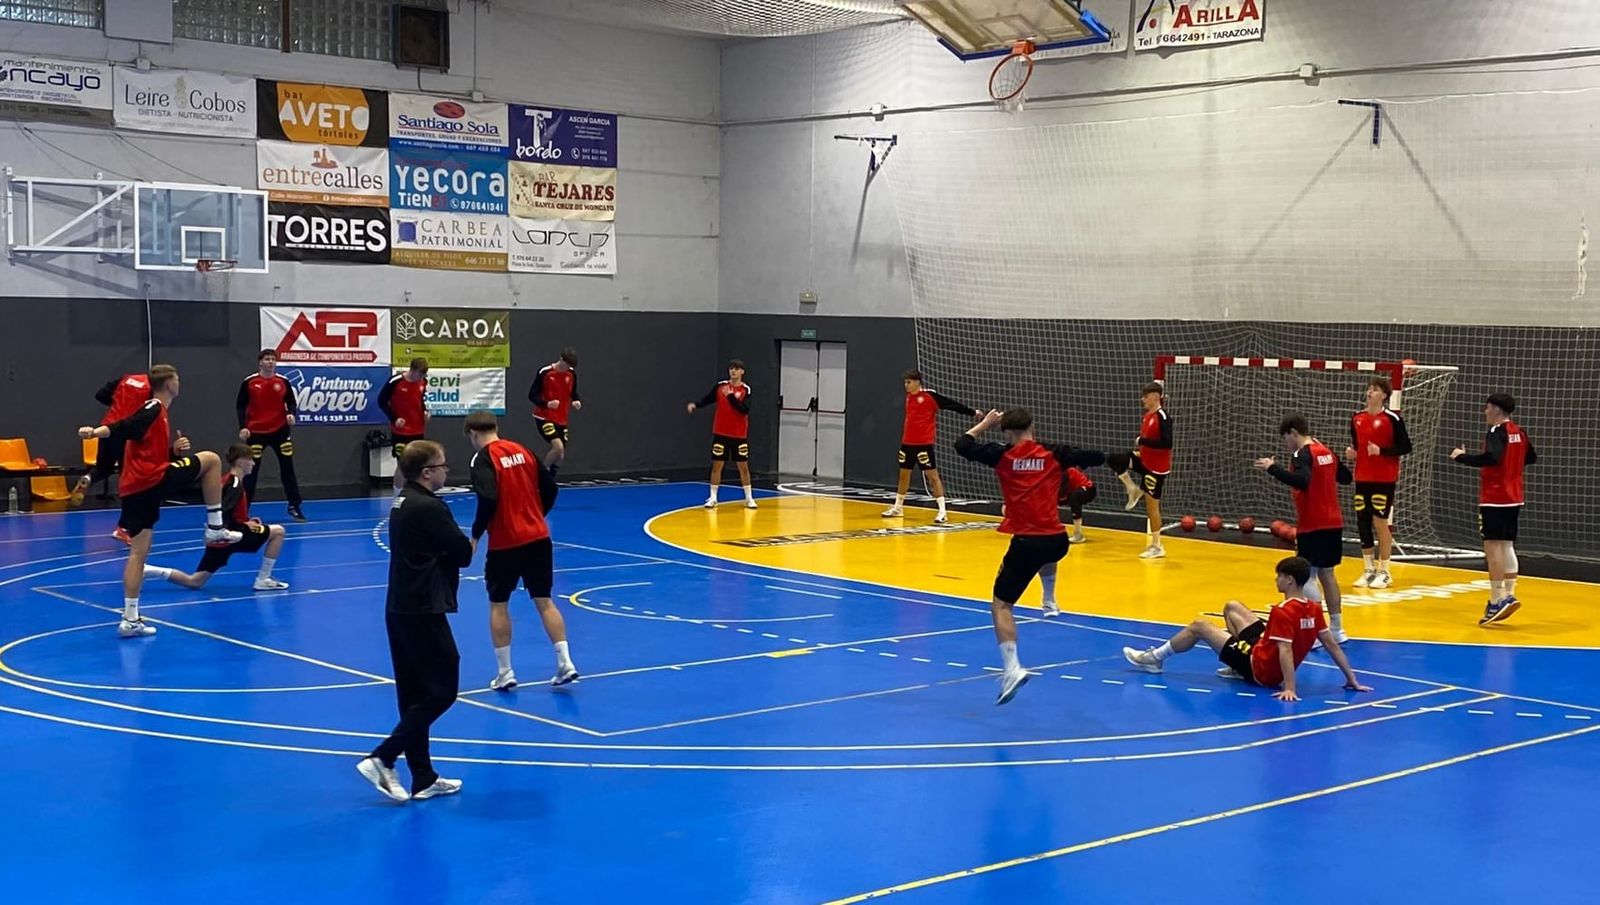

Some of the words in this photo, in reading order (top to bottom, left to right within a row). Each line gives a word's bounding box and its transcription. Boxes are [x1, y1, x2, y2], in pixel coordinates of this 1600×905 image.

[1173, 0, 1260, 28] ARILLA
[1213, 27, 1260, 39] TARAZONA
[3, 59, 101, 75] mantenimientos
[125, 83, 170, 107] Leire
[189, 89, 247, 113] Cobos
[138, 108, 172, 118] DIETISTA
[178, 110, 235, 122] NUTRICIONISTA
[279, 99, 370, 131] AVETO
[397, 114, 465, 134] Santiago
[467, 120, 500, 135] Sola
[516, 138, 562, 159] bordo
[262, 164, 384, 190] entrecalles
[394, 164, 506, 198] Yecora
[538, 170, 556, 182] BAR
[532, 180, 615, 202] TEJARES
[535, 201, 555, 209] SANTA
[555, 202, 574, 210] CRUZ
[574, 203, 584, 211] DE
[583, 204, 615, 213] MONCAYO
[267, 213, 388, 252] TORRES
[420, 218, 503, 237] CARBEA
[420, 235, 504, 249] PATRIMONIAL
[274, 311, 378, 351] ACP
[419, 317, 505, 339] CAROA
[312, 376, 373, 391] Pinturas
[290, 386, 369, 412] Morer
